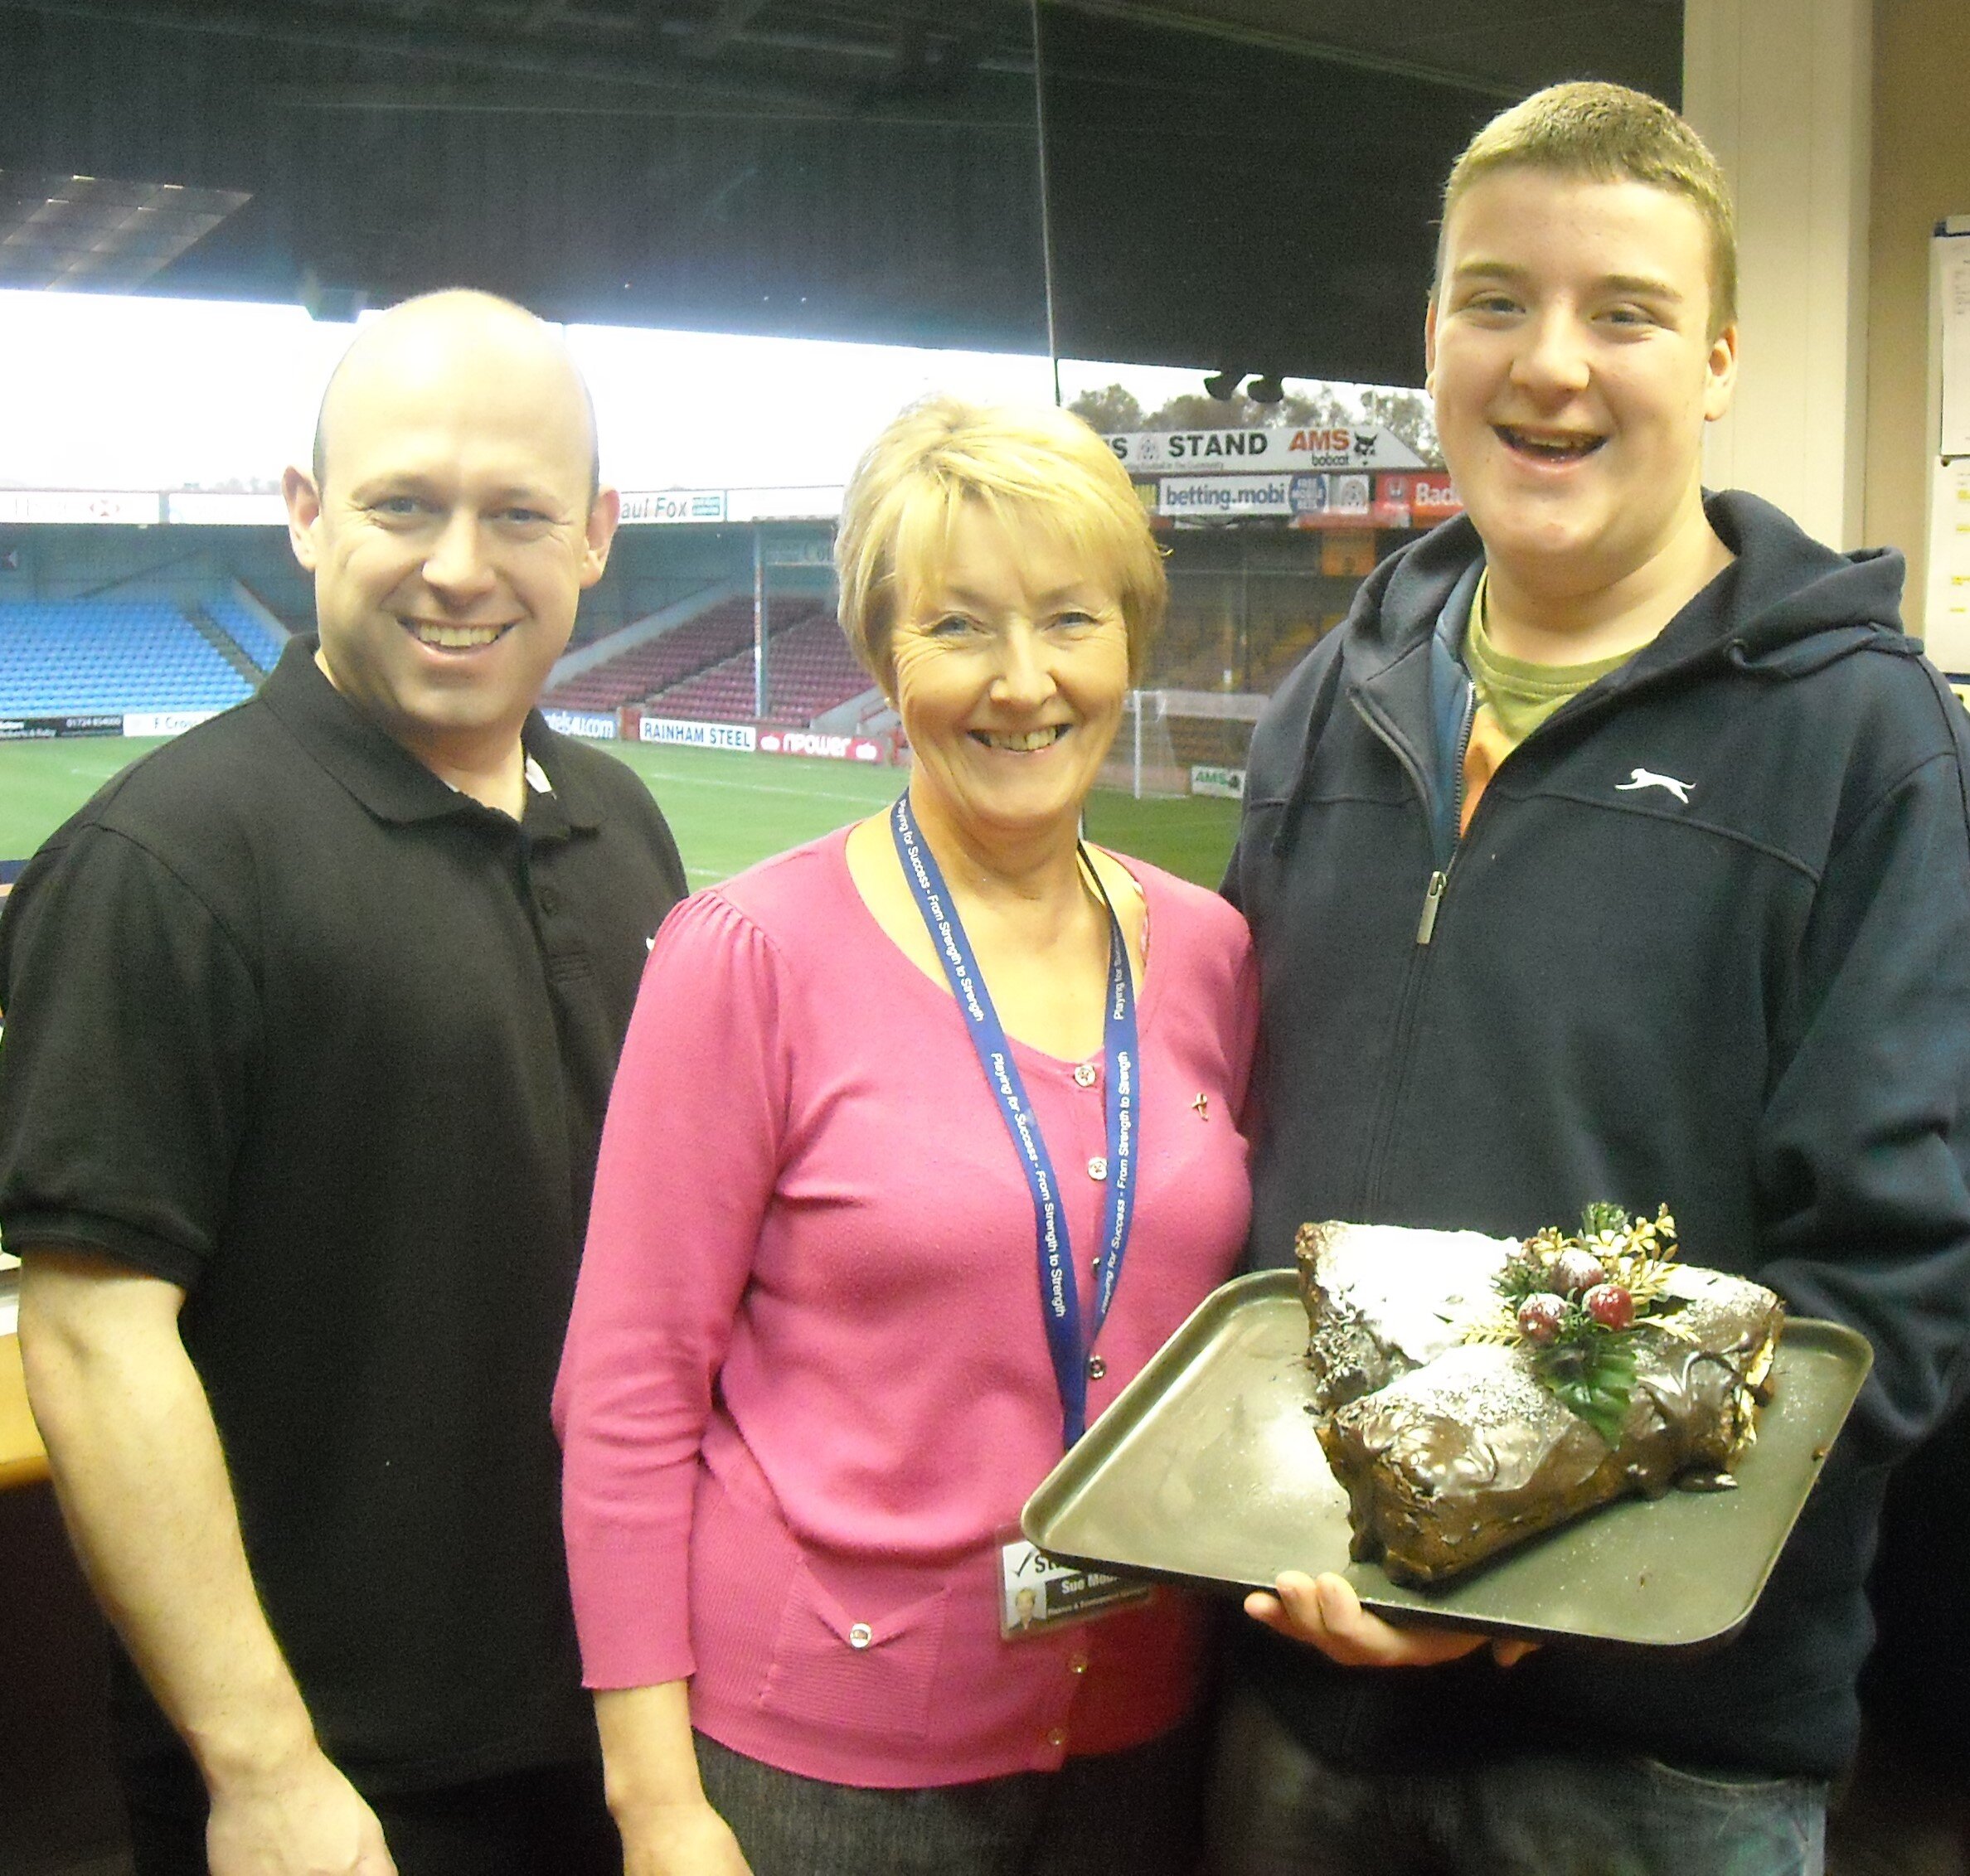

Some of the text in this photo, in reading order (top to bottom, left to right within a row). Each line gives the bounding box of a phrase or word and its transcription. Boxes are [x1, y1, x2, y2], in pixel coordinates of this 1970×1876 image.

[1168, 432, 1268, 457] STAND
[1288, 429, 1350, 452] AMS
[1312, 453, 1349, 467] bobcat
[621, 497, 649, 519] aul
[654, 497, 687, 518] Fox
[1166, 482, 1285, 511] betting.mobi
[644, 723, 751, 749] RAINHAM STEEL
[783, 733, 852, 758] npower
[903, 831, 914, 845] for
[908, 846, 930, 889] Success
[927, 894, 944, 922] From
[939, 922, 962, 966] Strength
[955, 965, 966, 977] to
[960, 977, 984, 1022] Strength
[1114, 982, 1126, 1020] Playing
[991, 1053, 1012, 1095] Playing
[1117, 1051, 1132, 1095] Strength
[1007, 1096, 1020, 1112] for
[1119, 1096, 1130, 1108] to
[1014, 1113, 1038, 1161] Success
[1118, 1110, 1132, 1156] Strength
[1036, 1171, 1051, 1201] From
[1117, 1159, 1128, 1189] From
[1044, 1202, 1058, 1253] Strength
[1111, 1199, 1126, 1249] Success
[1049, 1253, 1060, 1267] to
[1108, 1251, 1117, 1269] for
[1051, 1268, 1066, 1317] Strength
